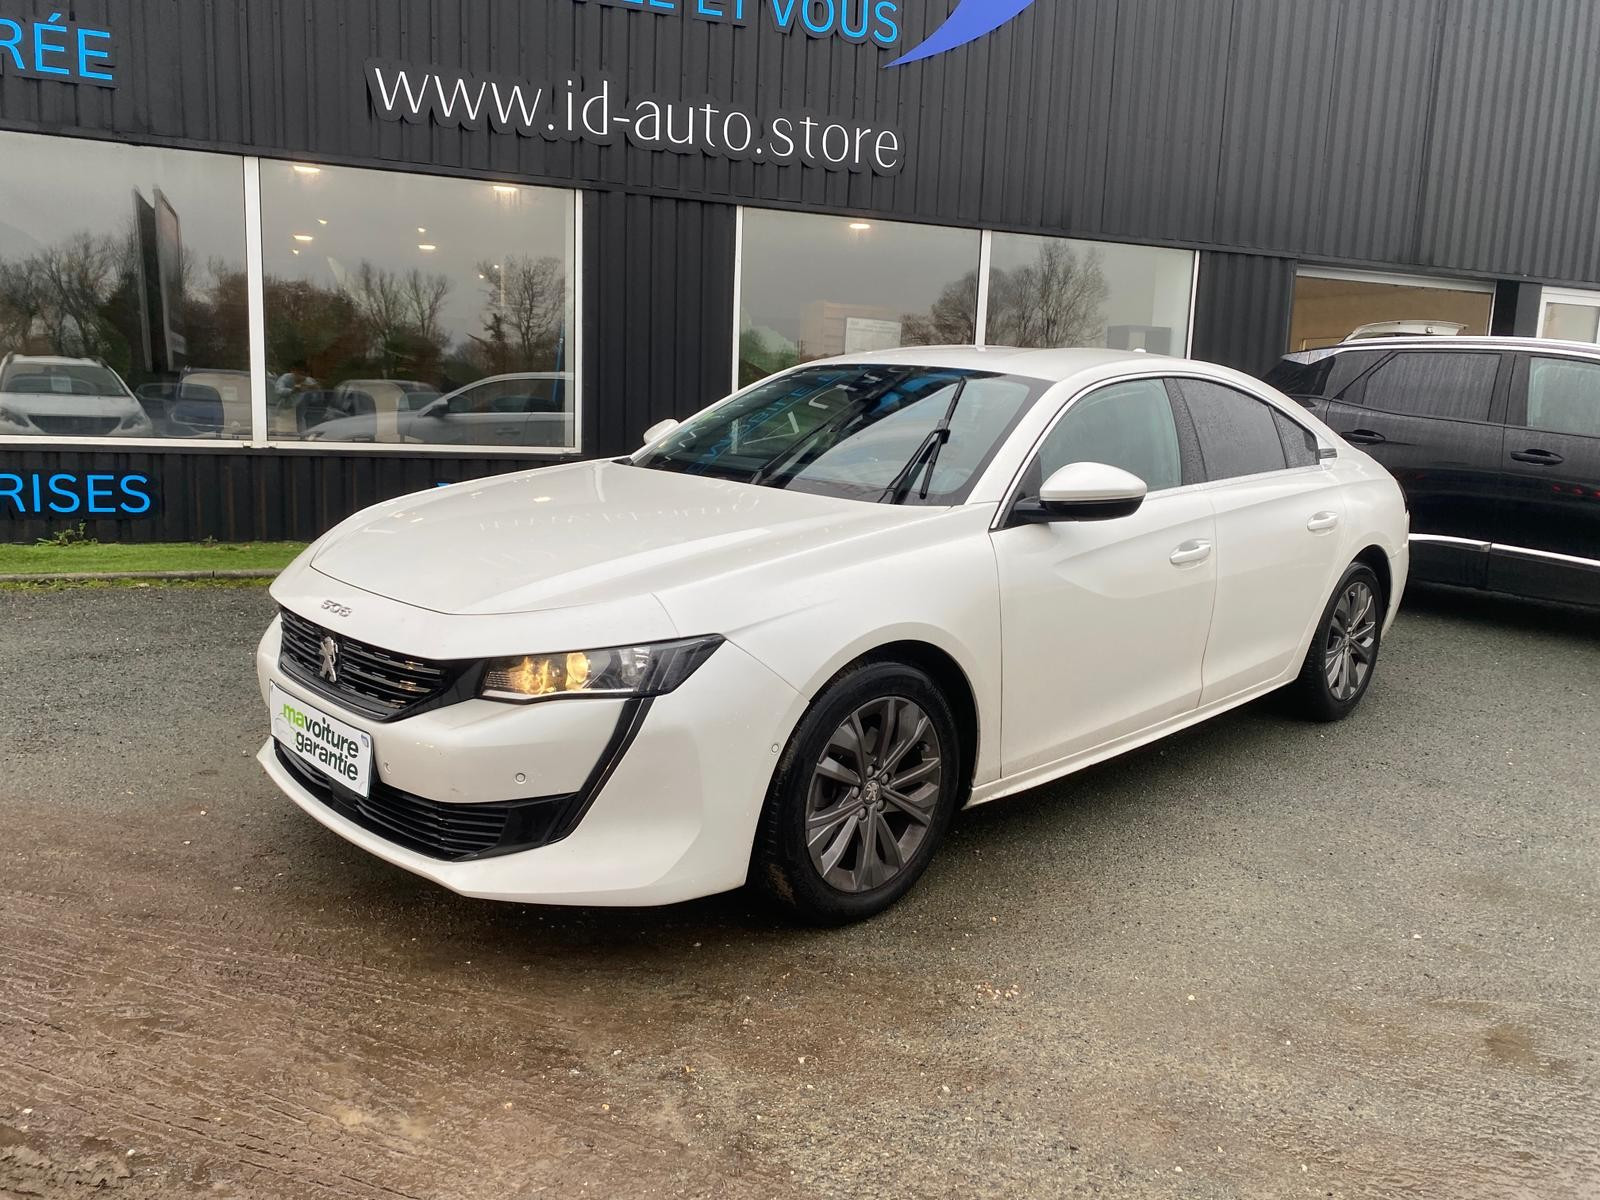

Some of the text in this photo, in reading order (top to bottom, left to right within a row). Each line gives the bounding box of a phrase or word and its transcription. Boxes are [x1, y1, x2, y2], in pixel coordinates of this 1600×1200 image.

[772, 0, 898, 43] VOUS
[0, 12, 113, 81] RÉE
[374, 67, 898, 168] www.id-auto.store
[0, 473, 151, 513] RISES
[321, 599, 352, 617] 508
[295, 731, 358, 781] garantie
